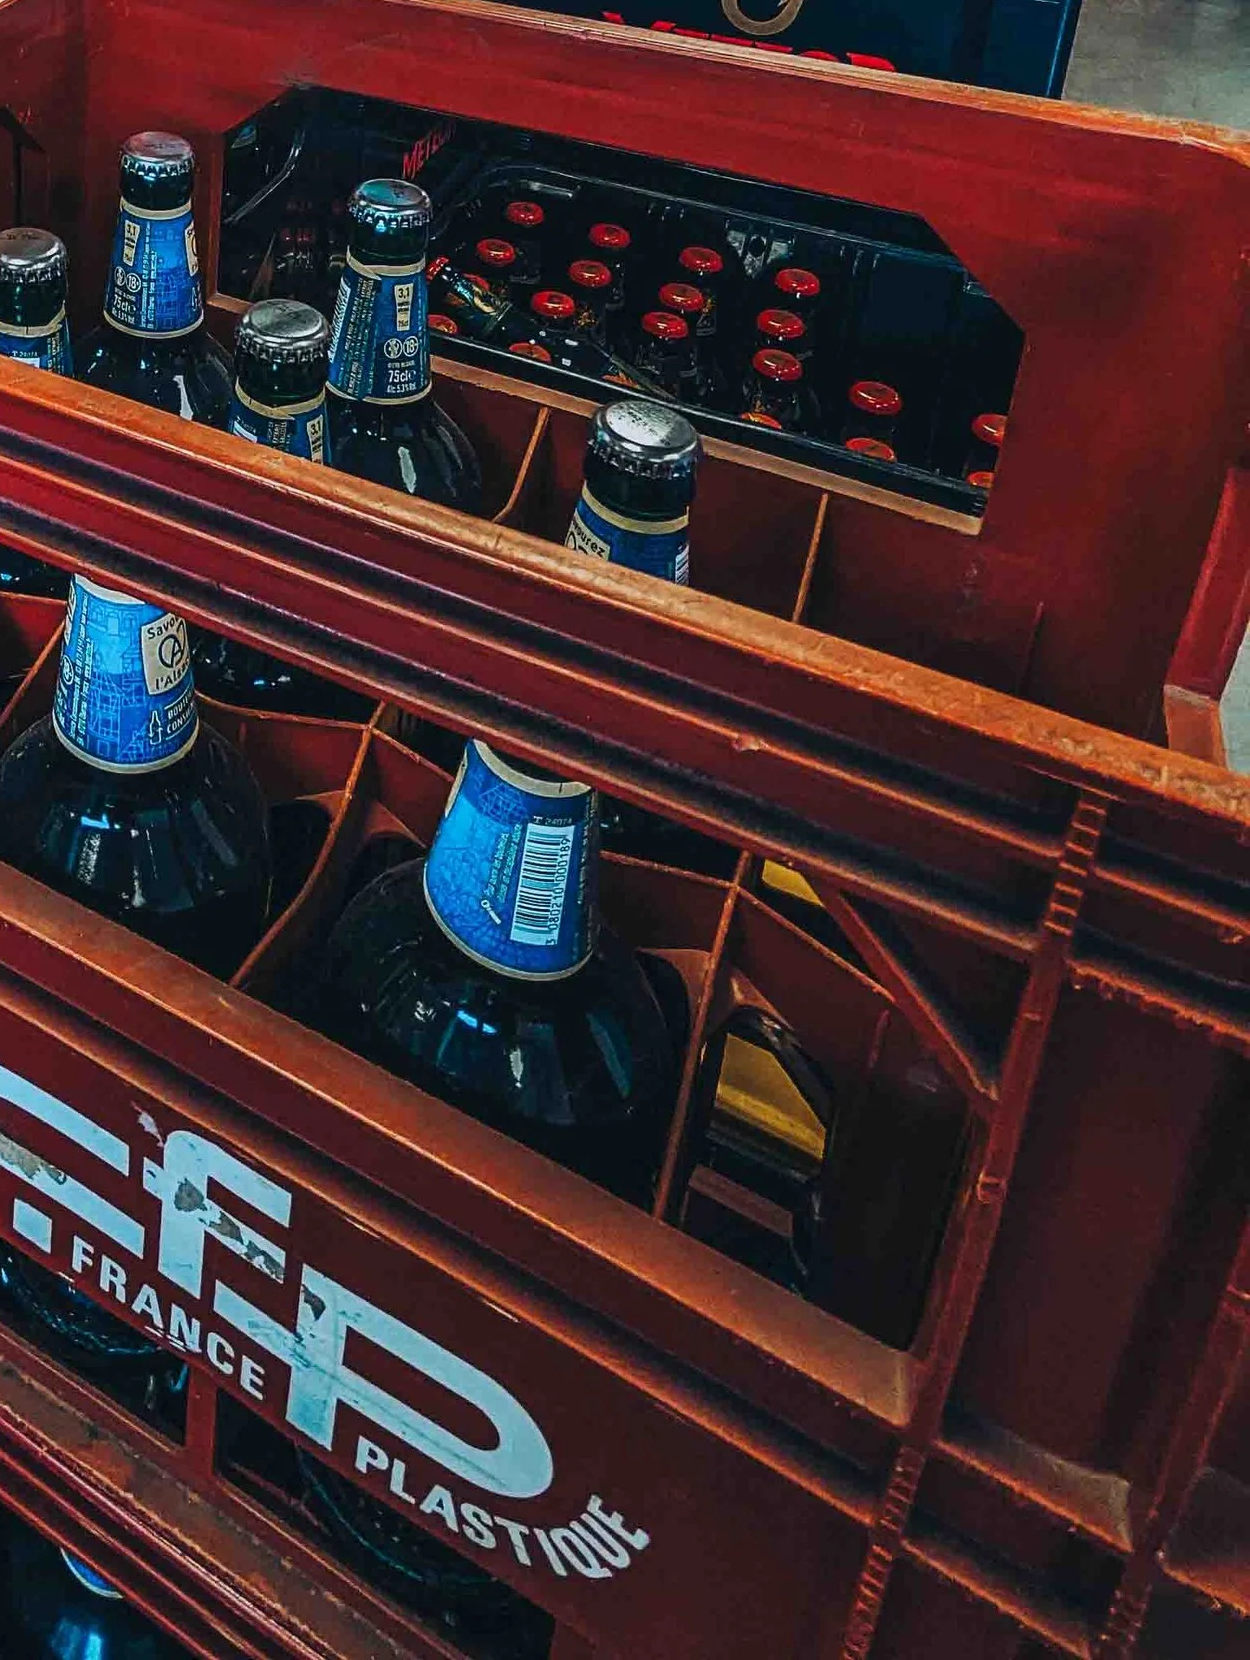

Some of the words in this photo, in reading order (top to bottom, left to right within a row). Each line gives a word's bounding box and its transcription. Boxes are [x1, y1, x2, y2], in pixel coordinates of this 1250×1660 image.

[398, 286, 410, 299] 3,1
[388, 370, 407, 383] 75cl
[310, 423, 321, 435] 3,1
[573, 520, 606, 557] vourez
[148, 616, 179, 639] Savo
[554, 837, 571, 884] 000189
[547, 885, 563, 930] 080210
[70, 1234, 268, 1403] FRANCE
[356, 1433, 652, 1582] PLASTIQUE
